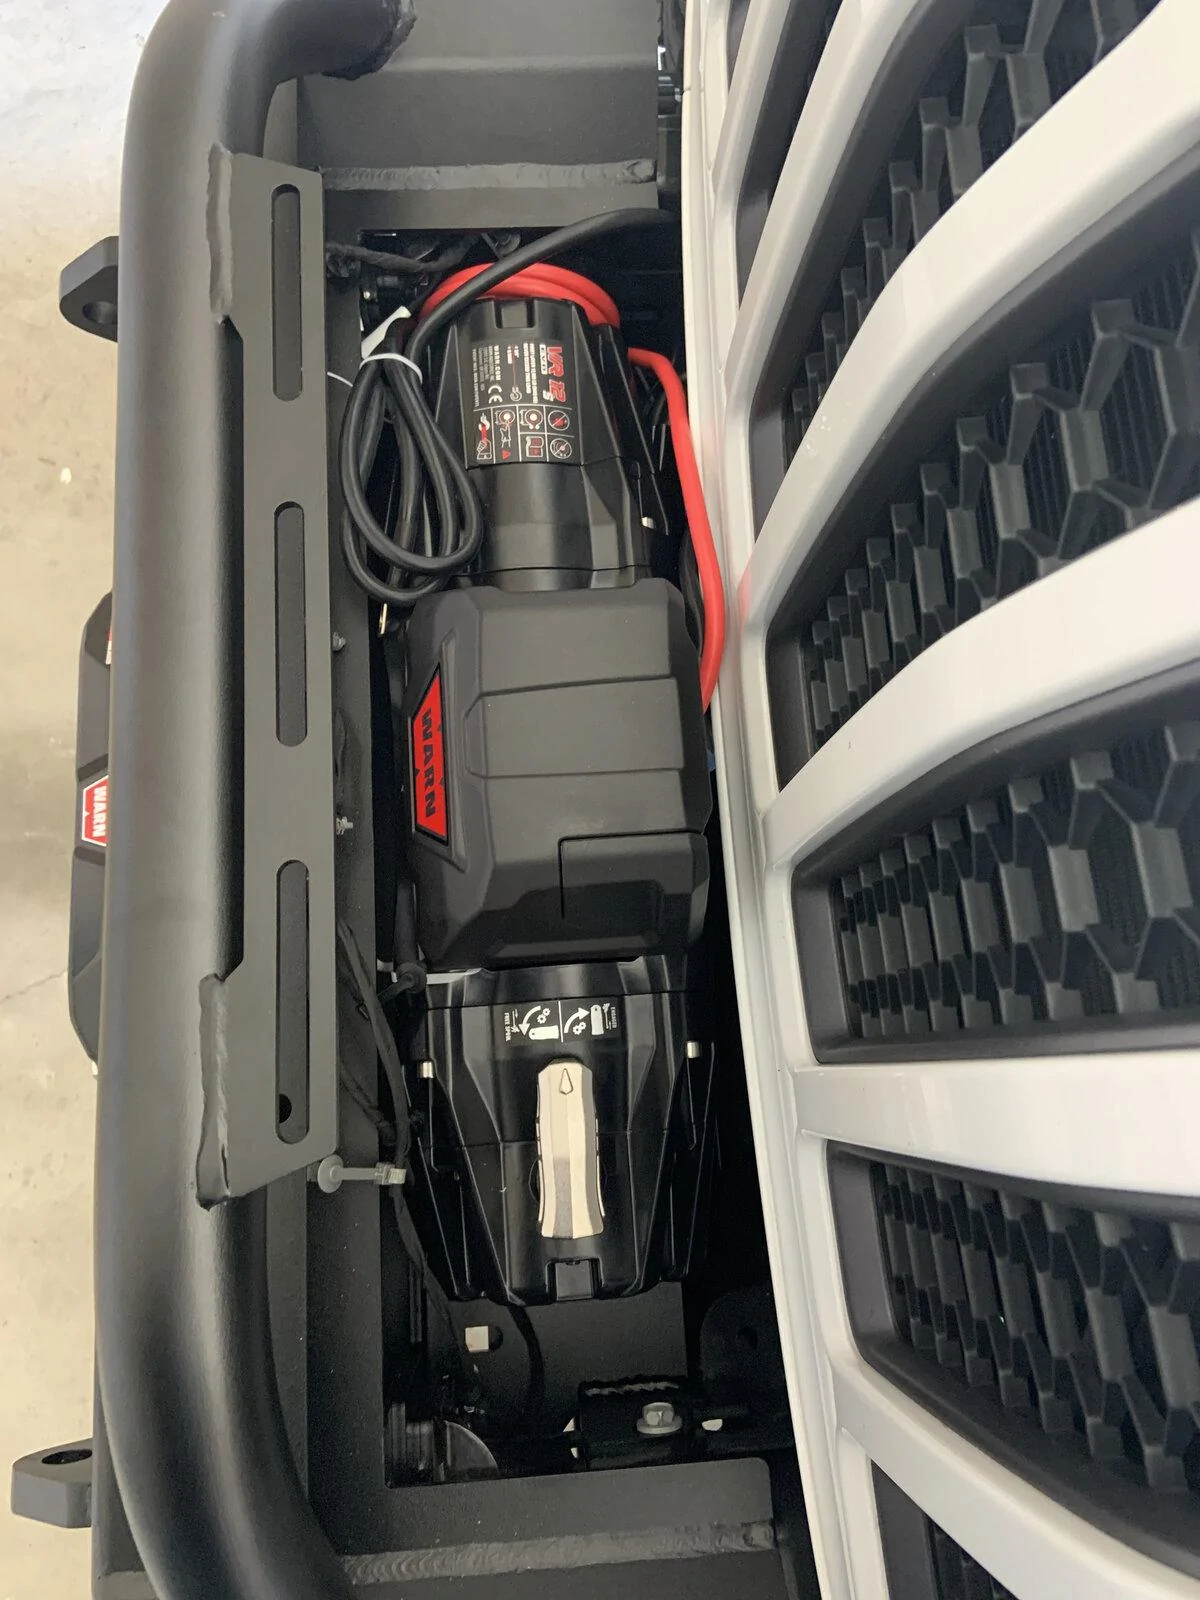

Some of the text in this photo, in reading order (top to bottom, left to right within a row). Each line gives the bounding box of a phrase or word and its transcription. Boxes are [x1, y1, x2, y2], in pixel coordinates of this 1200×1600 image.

[547, 346, 566, 402] VR 12
[421, 707, 436, 818] WARN
[92, 785, 108, 837] WARN
